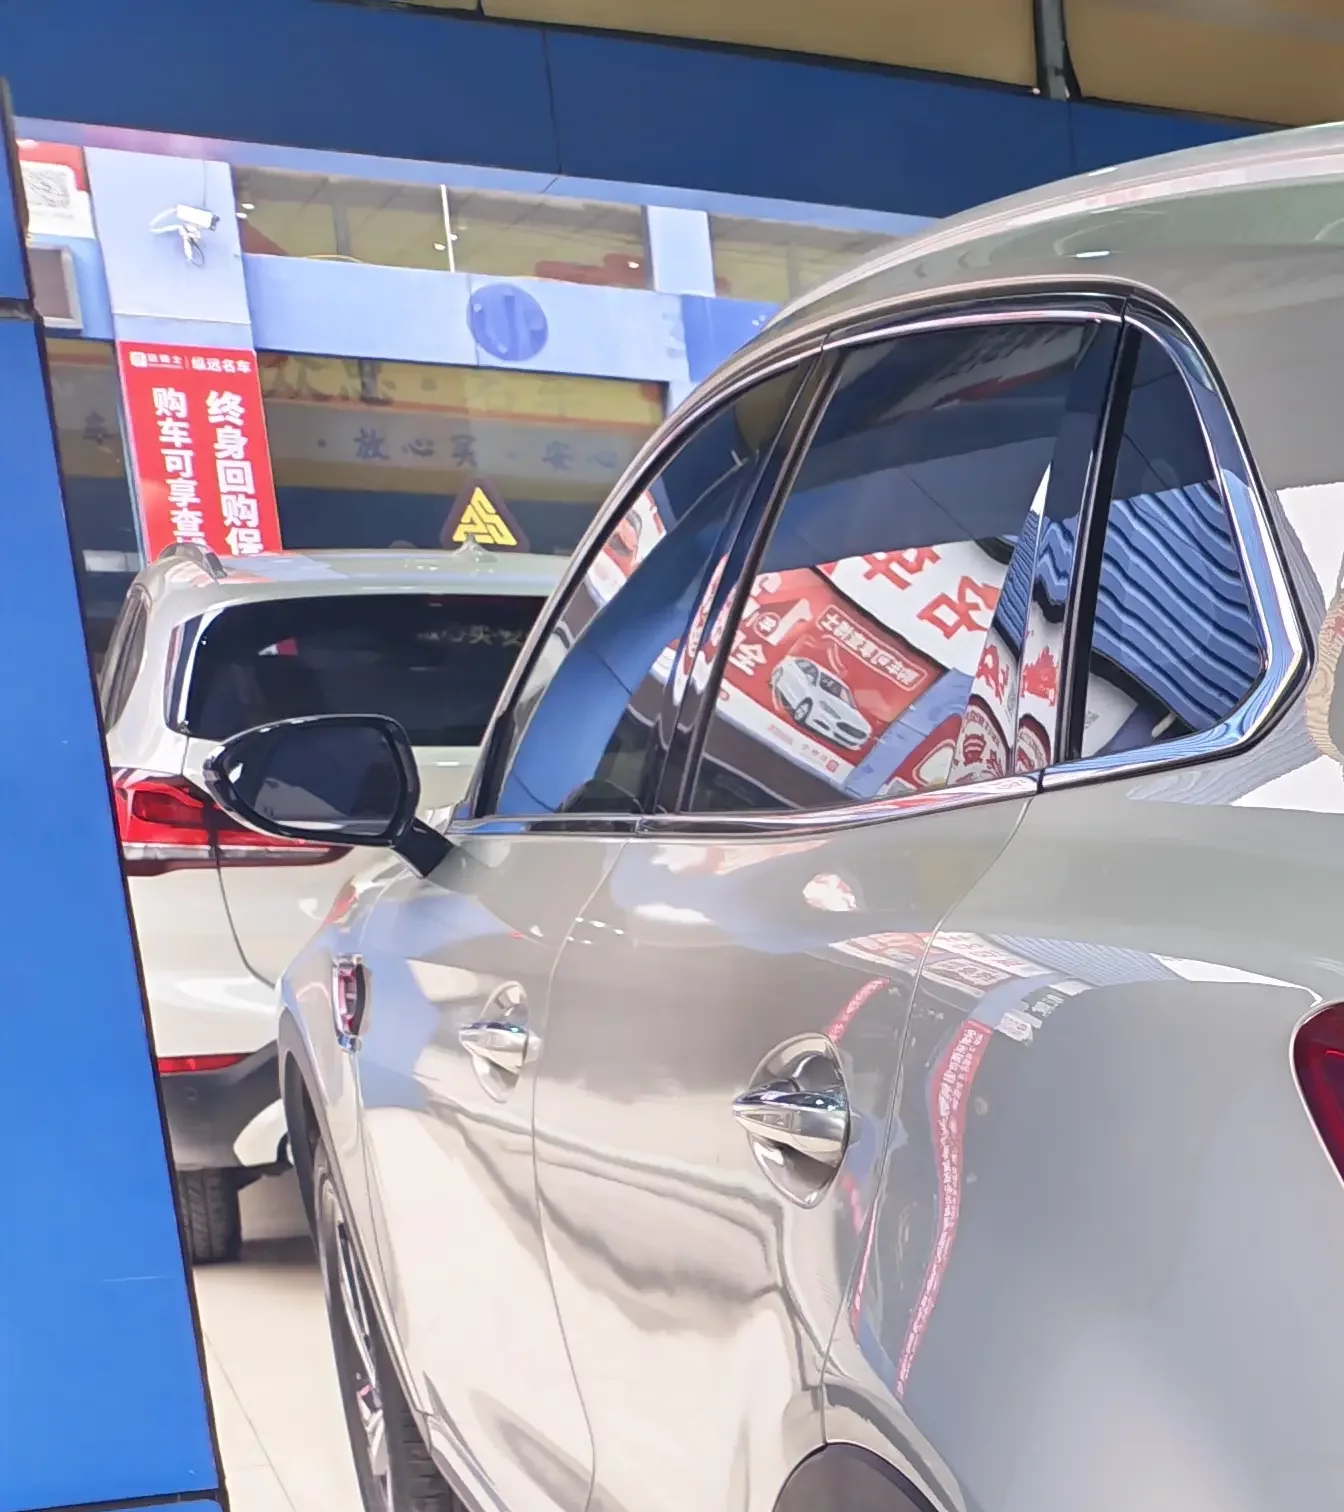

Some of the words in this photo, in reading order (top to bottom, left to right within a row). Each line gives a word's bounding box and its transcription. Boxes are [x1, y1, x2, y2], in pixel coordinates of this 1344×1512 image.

[152, 387, 205, 546] 购车可享查
[205, 390, 264, 556] 终身回购保
